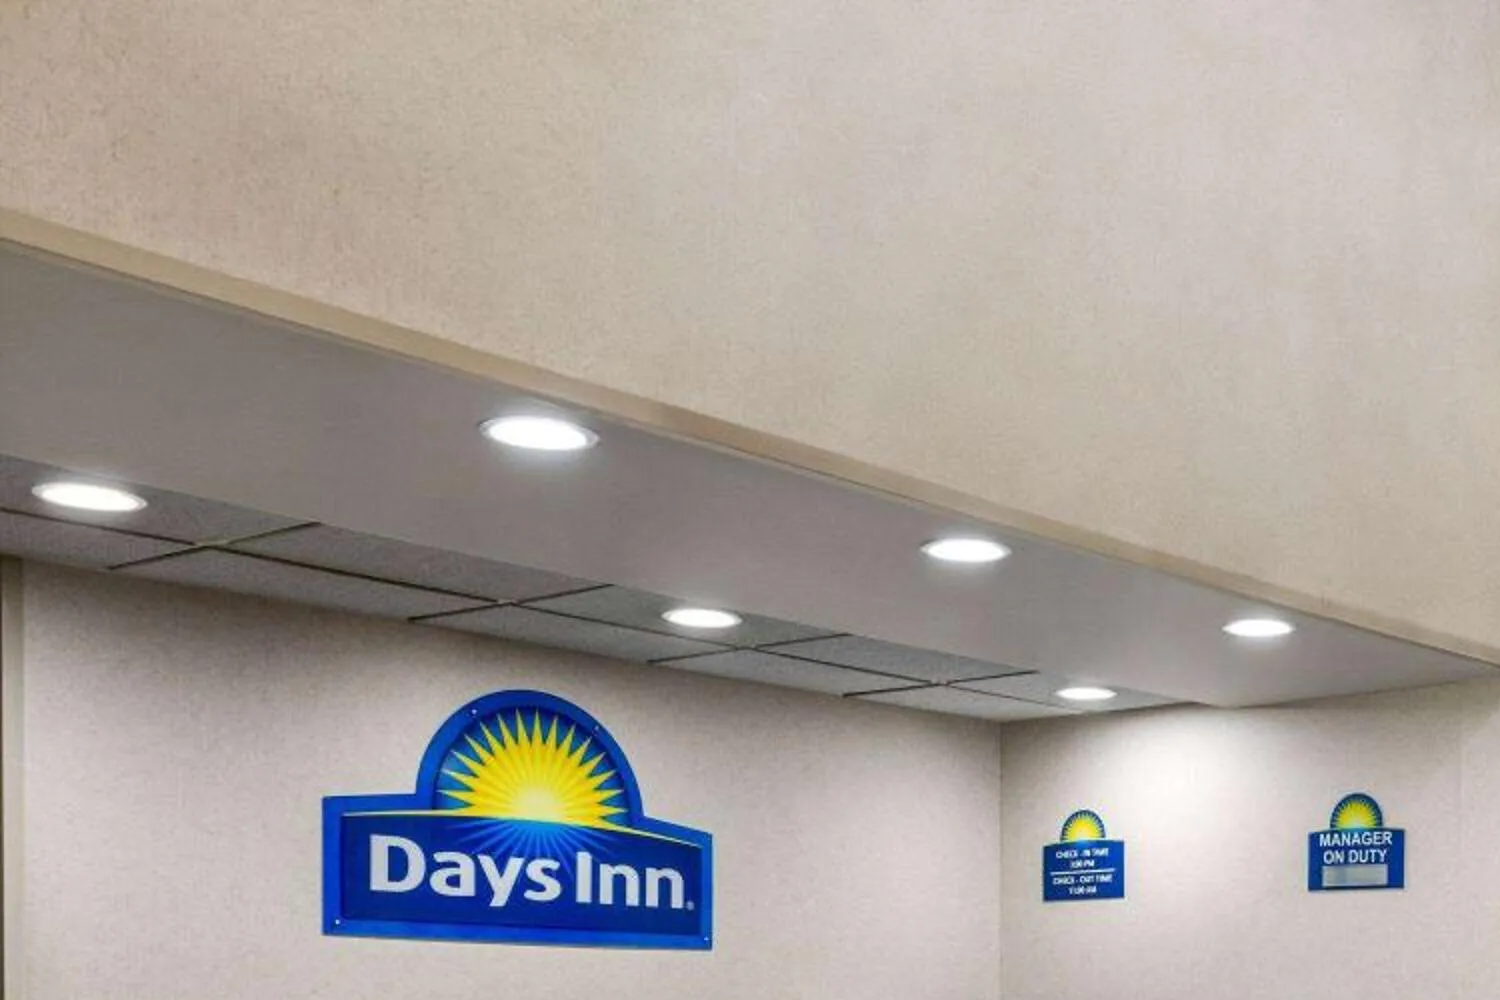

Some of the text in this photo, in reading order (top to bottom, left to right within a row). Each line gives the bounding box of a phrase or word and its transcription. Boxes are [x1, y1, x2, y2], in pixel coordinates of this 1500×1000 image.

[1319, 831, 1392, 847] MANAGER
[1323, 848, 1388, 864] ON DUTY
[369, 834, 563, 908] Days
